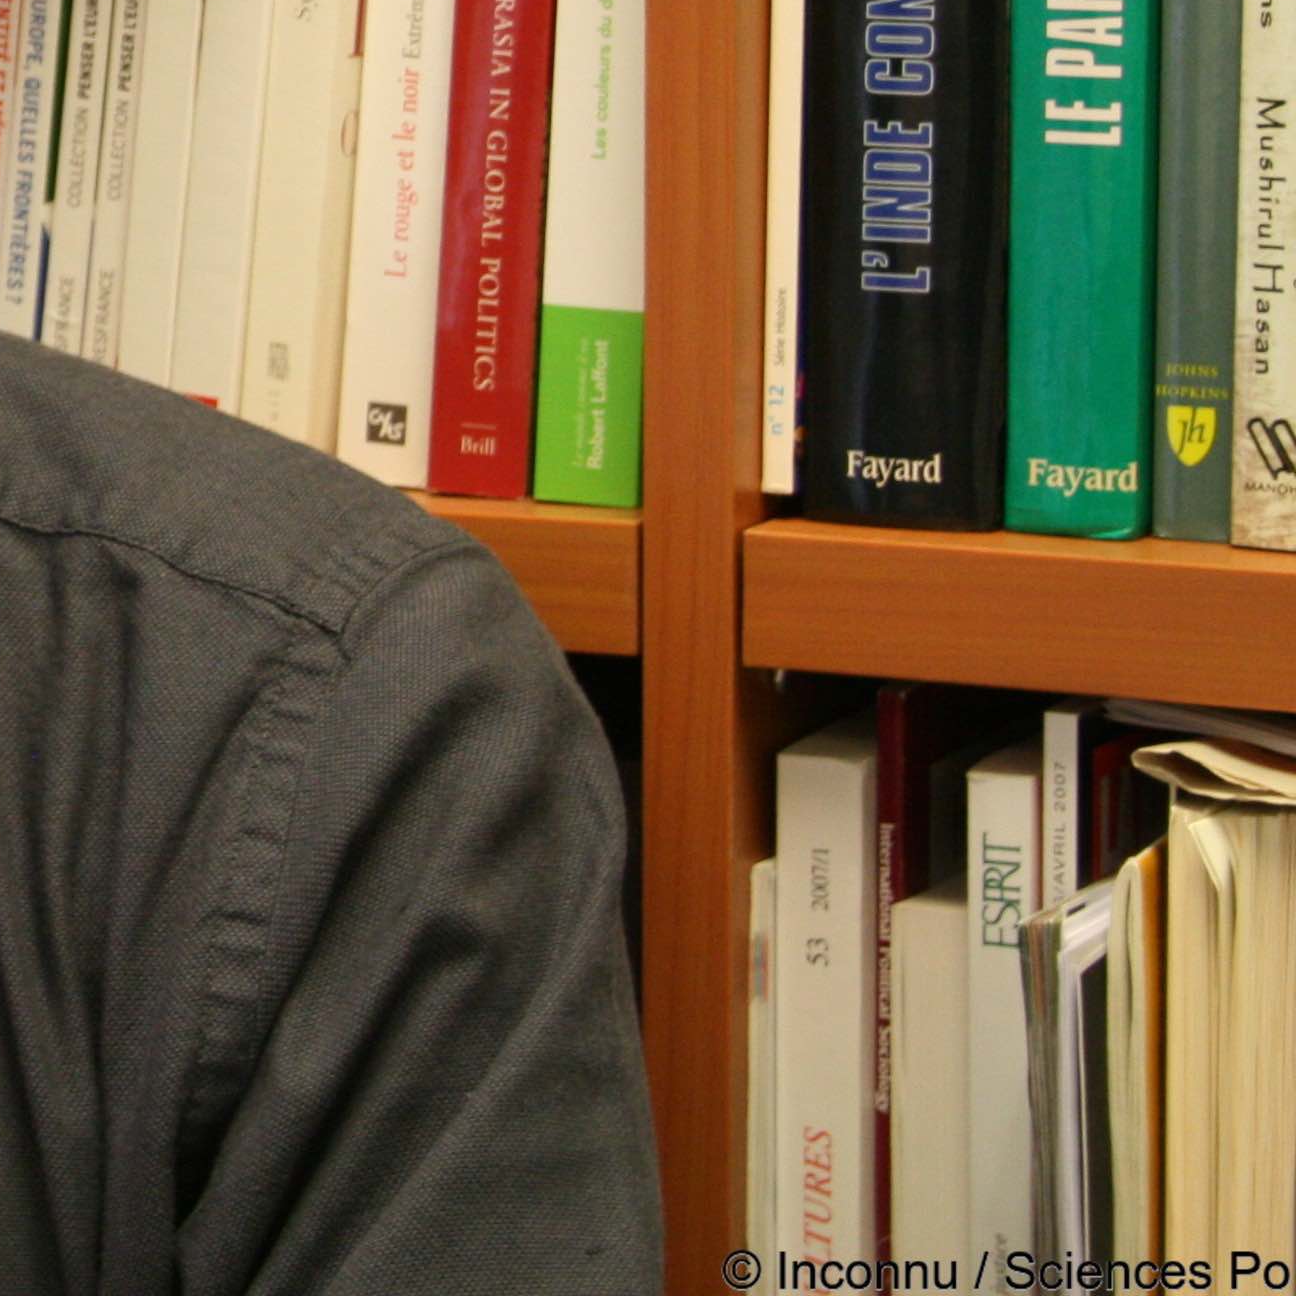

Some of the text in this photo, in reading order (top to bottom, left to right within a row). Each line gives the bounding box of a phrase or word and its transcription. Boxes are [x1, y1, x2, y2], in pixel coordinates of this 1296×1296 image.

[597, 11, 614, 36] du
[75, 40, 96, 100] PENSER
[116, 31, 138, 93] PENSER
[593, 40, 612, 125] couleurs
[401, 66, 423, 115] noir
[488, 90, 513, 122] IN
[394, 119, 416, 144] le
[1043, 98, 1124, 148] LE
[6, 76, 42, 291] QUELLES FRONTIÈRES
[396, 146, 416, 173] et
[391, 178, 418, 244] rouge
[478, 130, 509, 248] GLOBAL
[860, 119, 934, 295] L'INDE
[1253, 96, 1287, 376] Mushirul Hasan
[384, 247, 408, 281] Le
[472, 256, 501, 393] POLITICS
[1155, 383, 1230, 401] HOPKINS
[1166, 363, 1219, 378] JOHNS
[587, 338, 609, 471] Robert Laffont
[768, 383, 785, 410] 12
[459, 434, 497, 458] Brill
[846, 448, 943, 489] Fayard
[1027, 457, 1139, 498] Fayard
[1053, 761, 1068, 813] 2007
[806, 846, 832, 968] 53 2007/1
[982, 831, 1024, 952] ESPRIT
